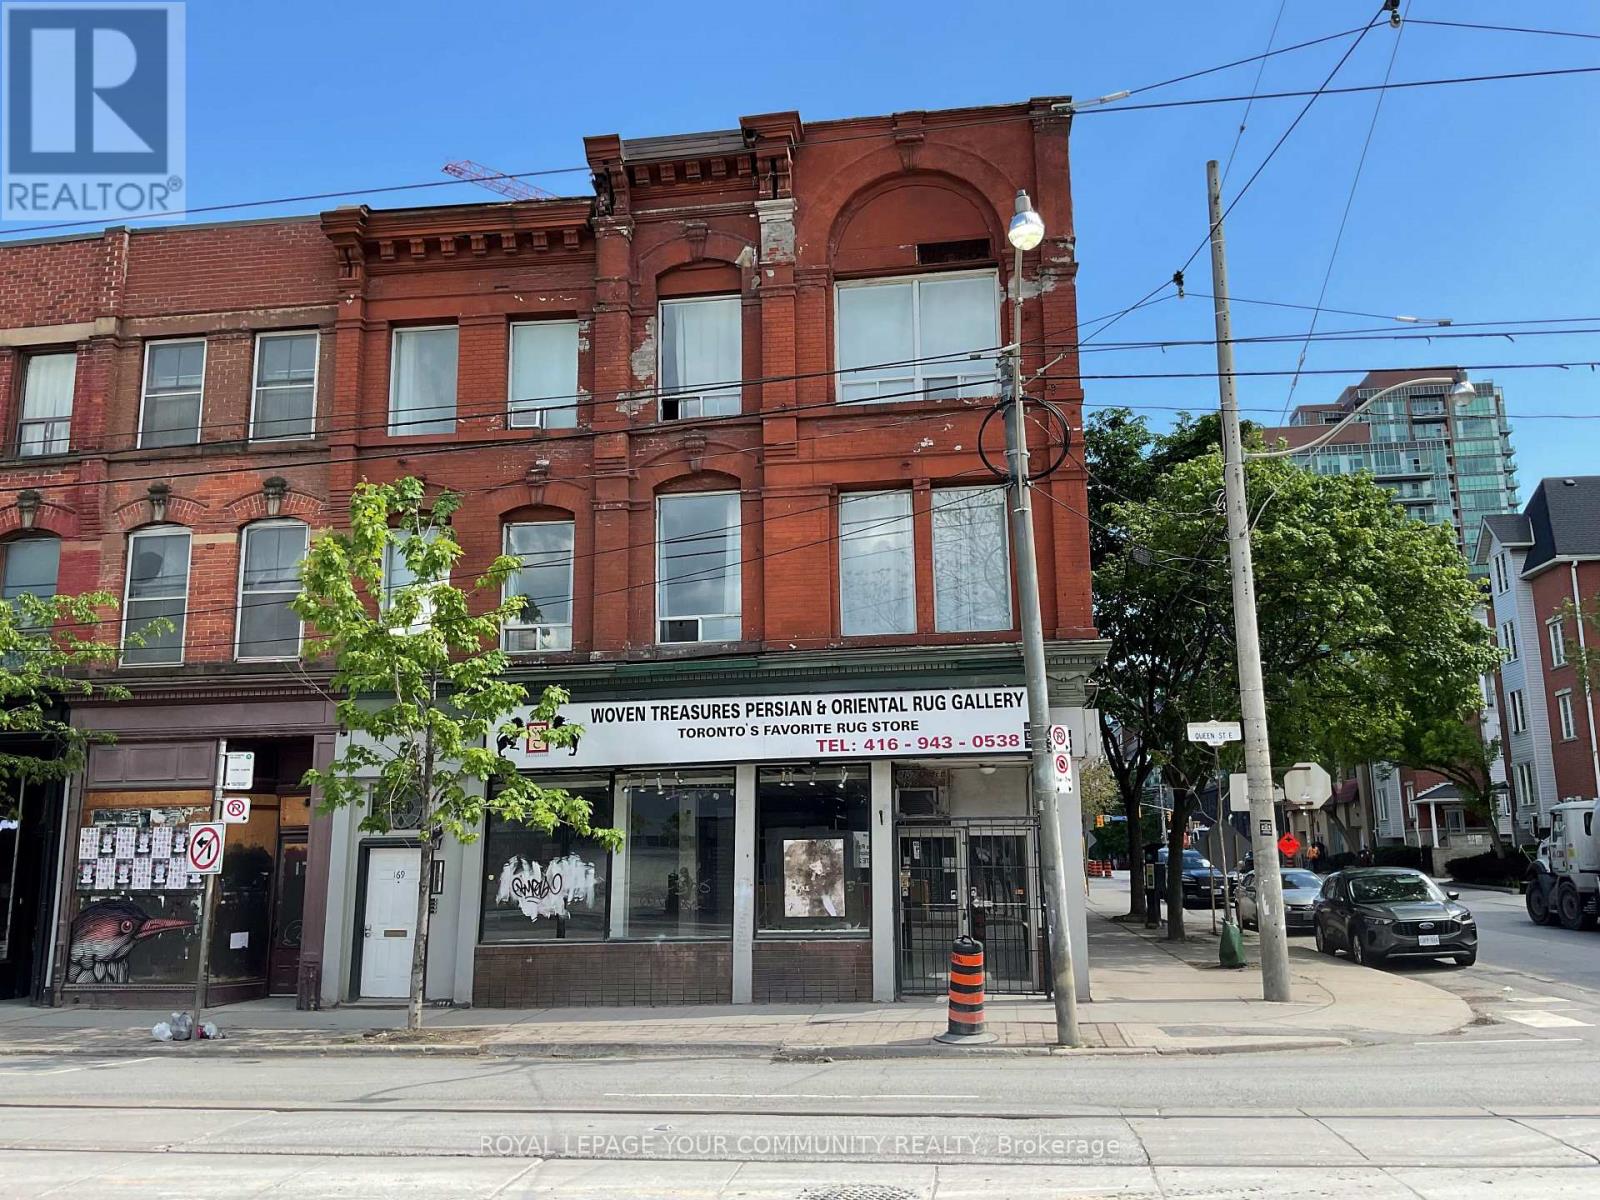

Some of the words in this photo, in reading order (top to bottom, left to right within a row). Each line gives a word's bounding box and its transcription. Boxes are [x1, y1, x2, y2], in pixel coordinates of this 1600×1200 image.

[591, 706, 646, 723] WOVEN
[651, 701, 741, 721] TREASURES
[746, 699, 812, 718] PERSIAN
[817, 700, 827, 715] &
[831, 696, 908, 715] ORIENTAL
[913, 694, 946, 711] RUG
[951, 691, 1024, 710] GALLERY
[678, 722, 759, 739] TORONTO'S
[764, 723, 832, 736] FAVORITE
[837, 721, 867, 734] RUG
[872, 720, 919, 732] STORE
[1195, 732, 1215, 740] QUEEN
[816, 739, 857, 753] TEL:
[863, 737, 899, 751] 416
[917, 736, 952, 750] 943
[972, 734, 1020, 748] 0538
[393, 870, 406, 880] 169
